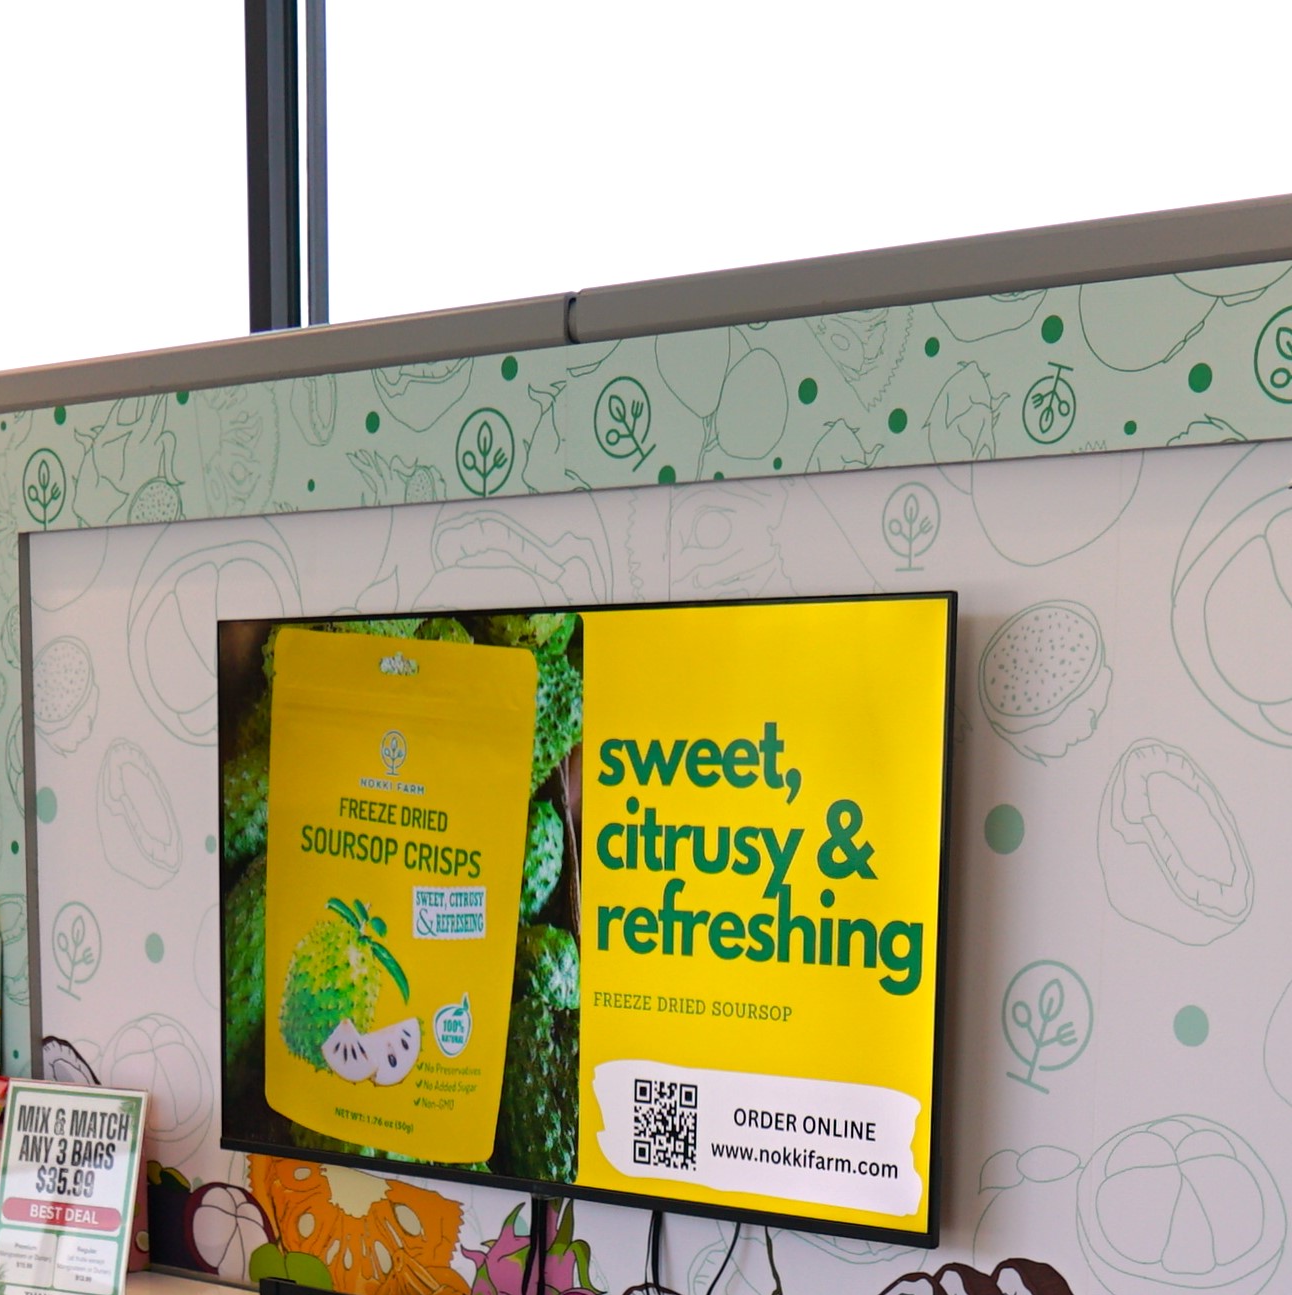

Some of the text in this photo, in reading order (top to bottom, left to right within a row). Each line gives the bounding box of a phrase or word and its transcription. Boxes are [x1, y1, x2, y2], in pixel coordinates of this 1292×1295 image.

[598, 722, 802, 805] sweet,
[360, 778, 424, 795] NOKKI FARM
[339, 797, 447, 832] FREEZE DRIED
[301, 825, 481, 878] SOURSOP CRISPS
[596, 797, 878, 899] citrusy &
[416, 891, 484, 910] SWEET, CITRUSY
[597, 878, 924, 996] refreshing
[593, 992, 793, 1022] FREEZE DRIED SOURSOP
[443, 1019, 464, 1033] 100%
[17, 1105, 130, 1142] MIX & MATCH
[733, 1108, 876, 1141] ORDER ONLINE
[19, 1135, 116, 1170] ANY 3 BAGS
[711, 1142, 899, 1180] www.nokkifarm.com
[36, 1165, 95, 1198] $35.99
[30, 1204, 98, 1224] BEST DEAL
